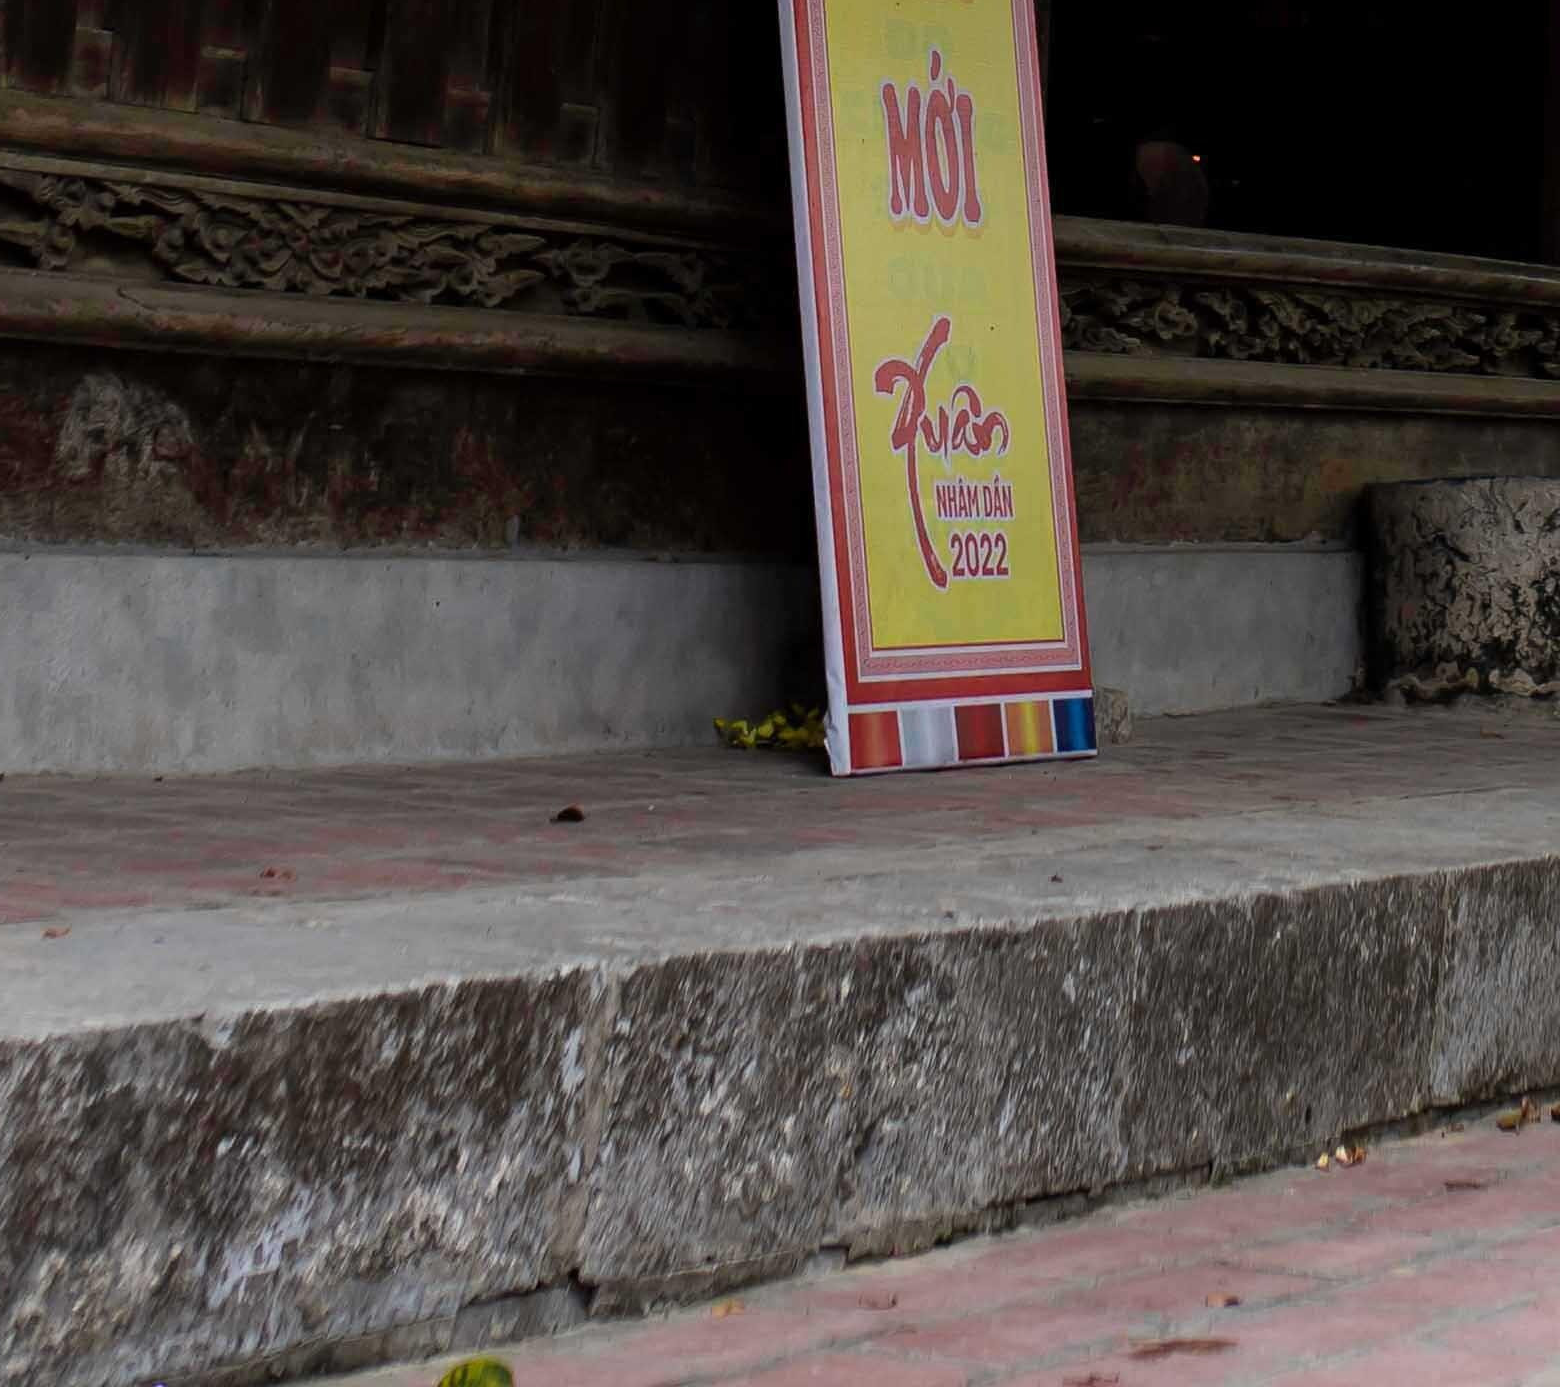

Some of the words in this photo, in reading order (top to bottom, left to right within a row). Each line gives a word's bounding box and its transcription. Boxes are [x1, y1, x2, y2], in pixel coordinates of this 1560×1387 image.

[881, 48, 981, 226] MỚI
[875, 316, 1009, 589] Xuân
[935, 477, 980, 518] NHÂM
[950, 532, 1009, 578] 2022
